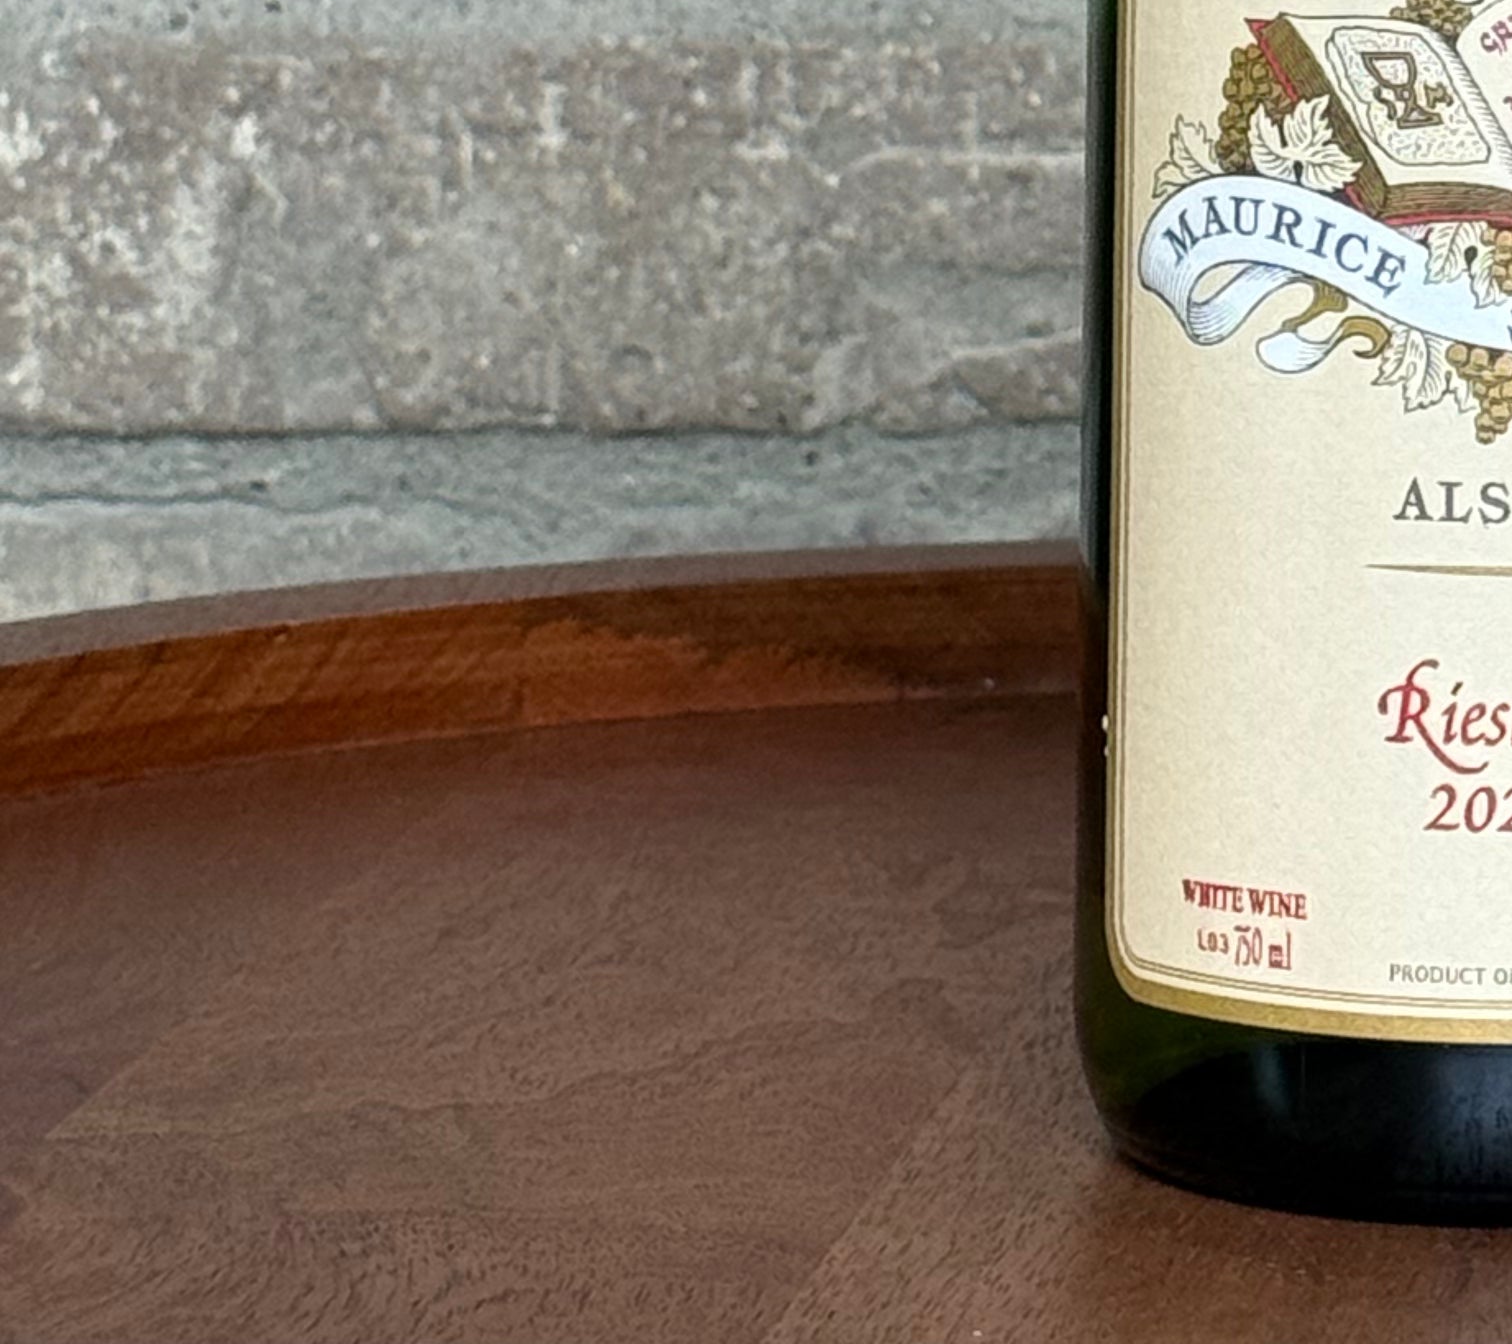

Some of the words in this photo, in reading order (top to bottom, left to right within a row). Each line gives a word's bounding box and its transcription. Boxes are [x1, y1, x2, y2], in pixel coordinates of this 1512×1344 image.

[1160, 194, 1408, 297] MAURICE
[1182, 879, 1244, 913] WHITE
[1246, 888, 1307, 920] WINE
[1389, 963, 1487, 986] PRODUCT
